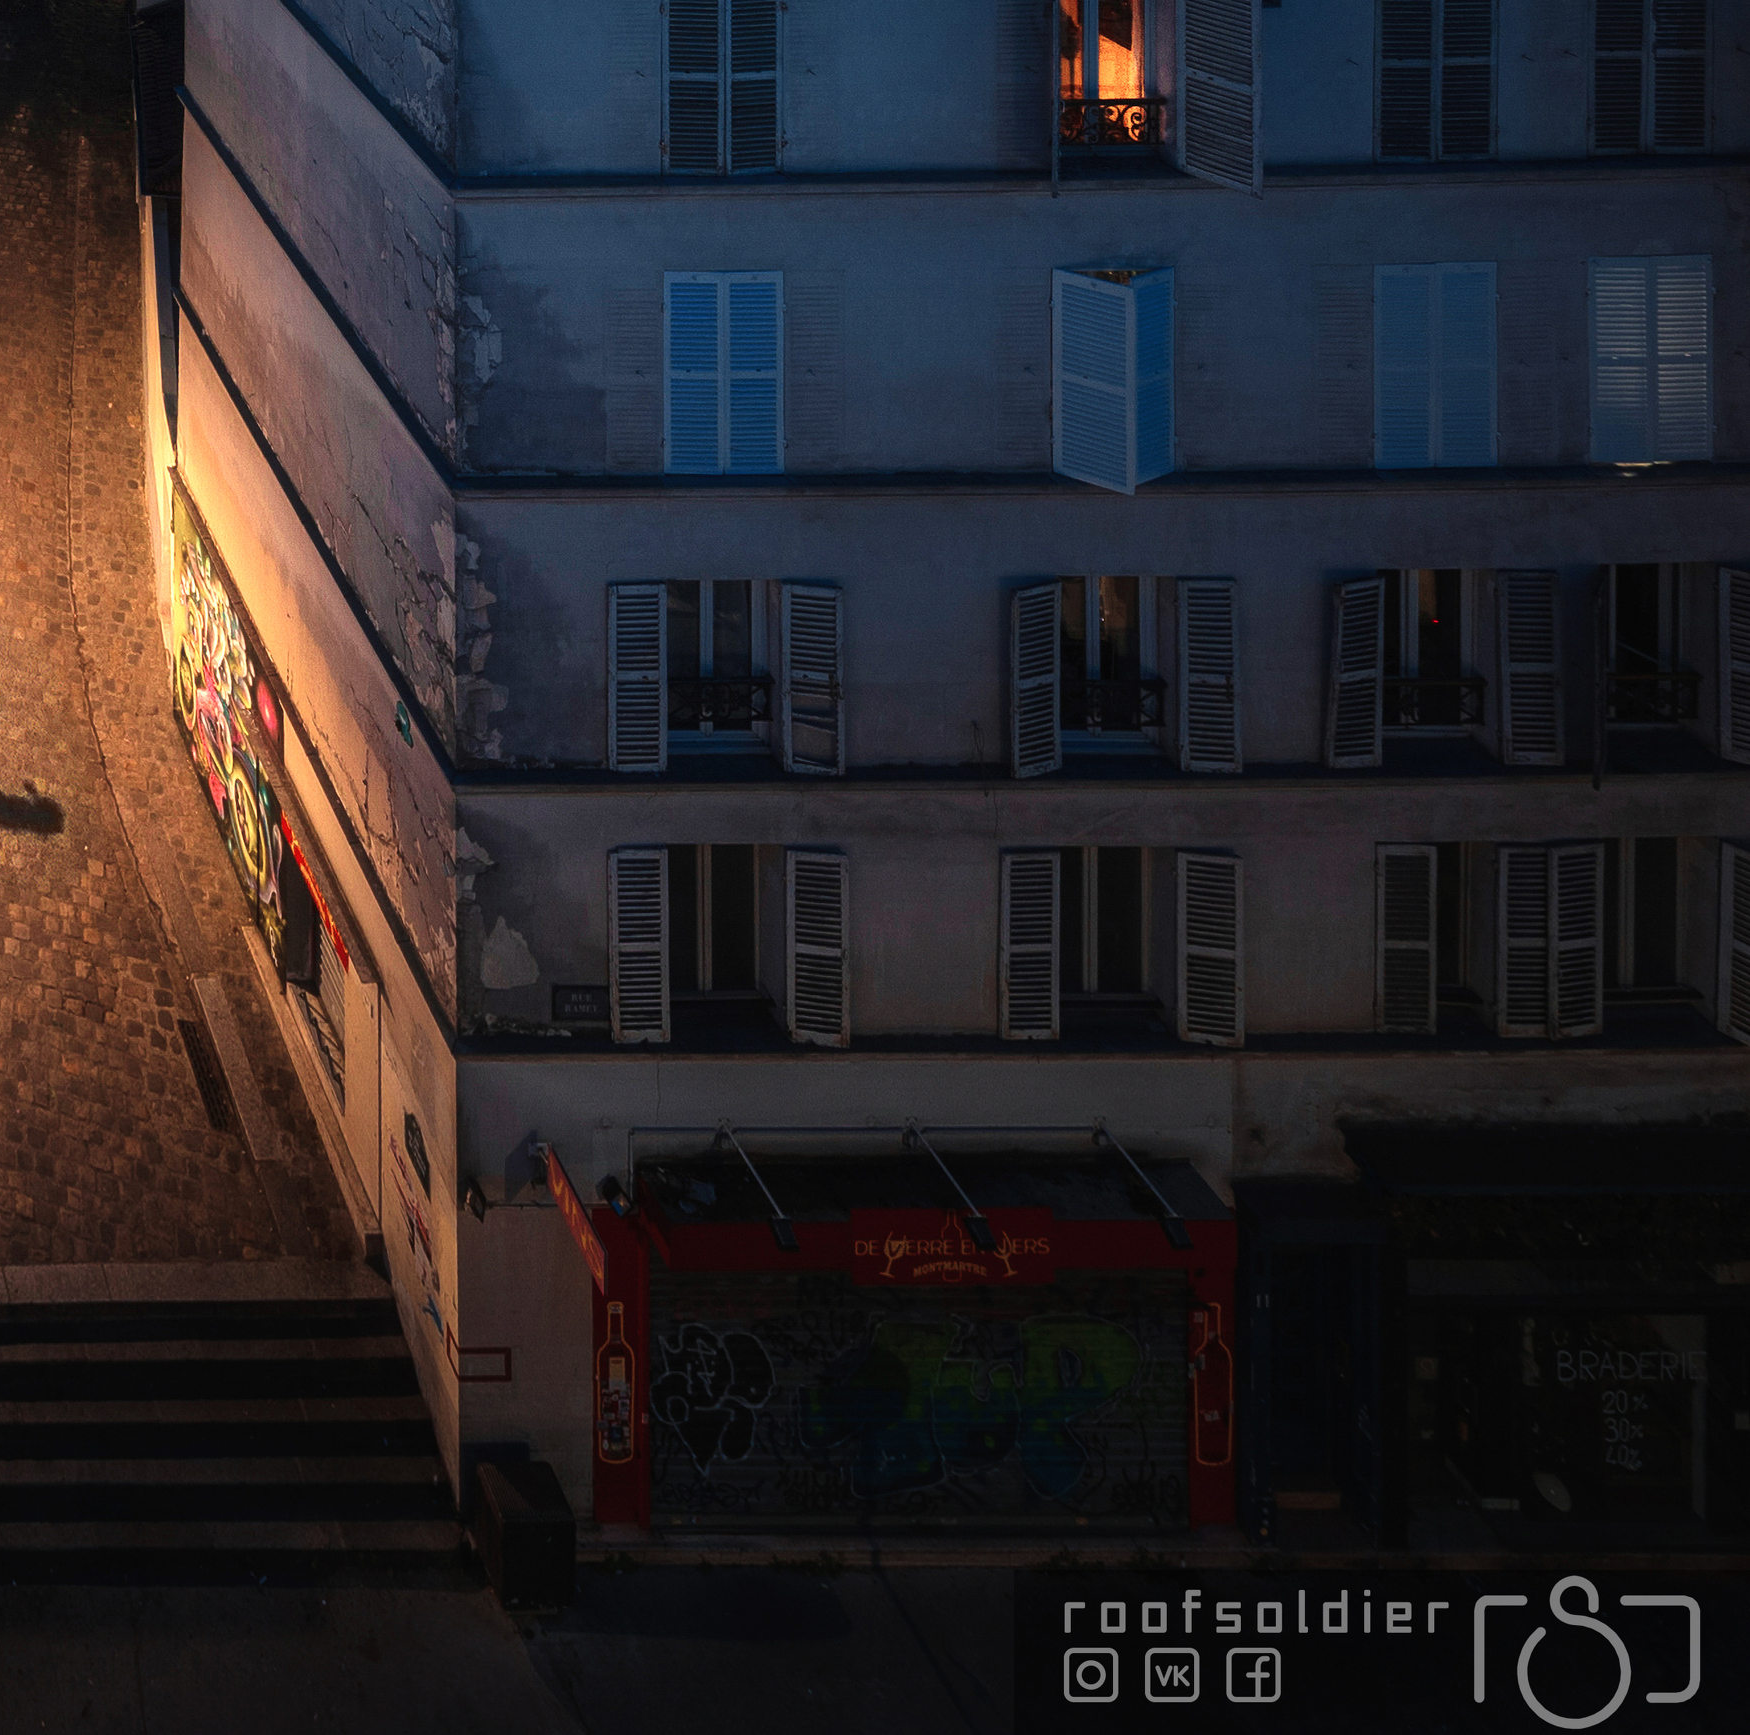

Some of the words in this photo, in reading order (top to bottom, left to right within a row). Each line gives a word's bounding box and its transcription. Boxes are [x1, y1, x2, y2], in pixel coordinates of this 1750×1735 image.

[571, 994, 593, 1002] RUE
[854, 1239, 880, 1256] DE
[885, 1238, 955, 1257] VERRE
[912, 1260, 988, 1278] MONTMARTRE
[1557, 1350, 1707, 1383] BRADERIE
[1604, 1417, 1644, 1443] 30%
